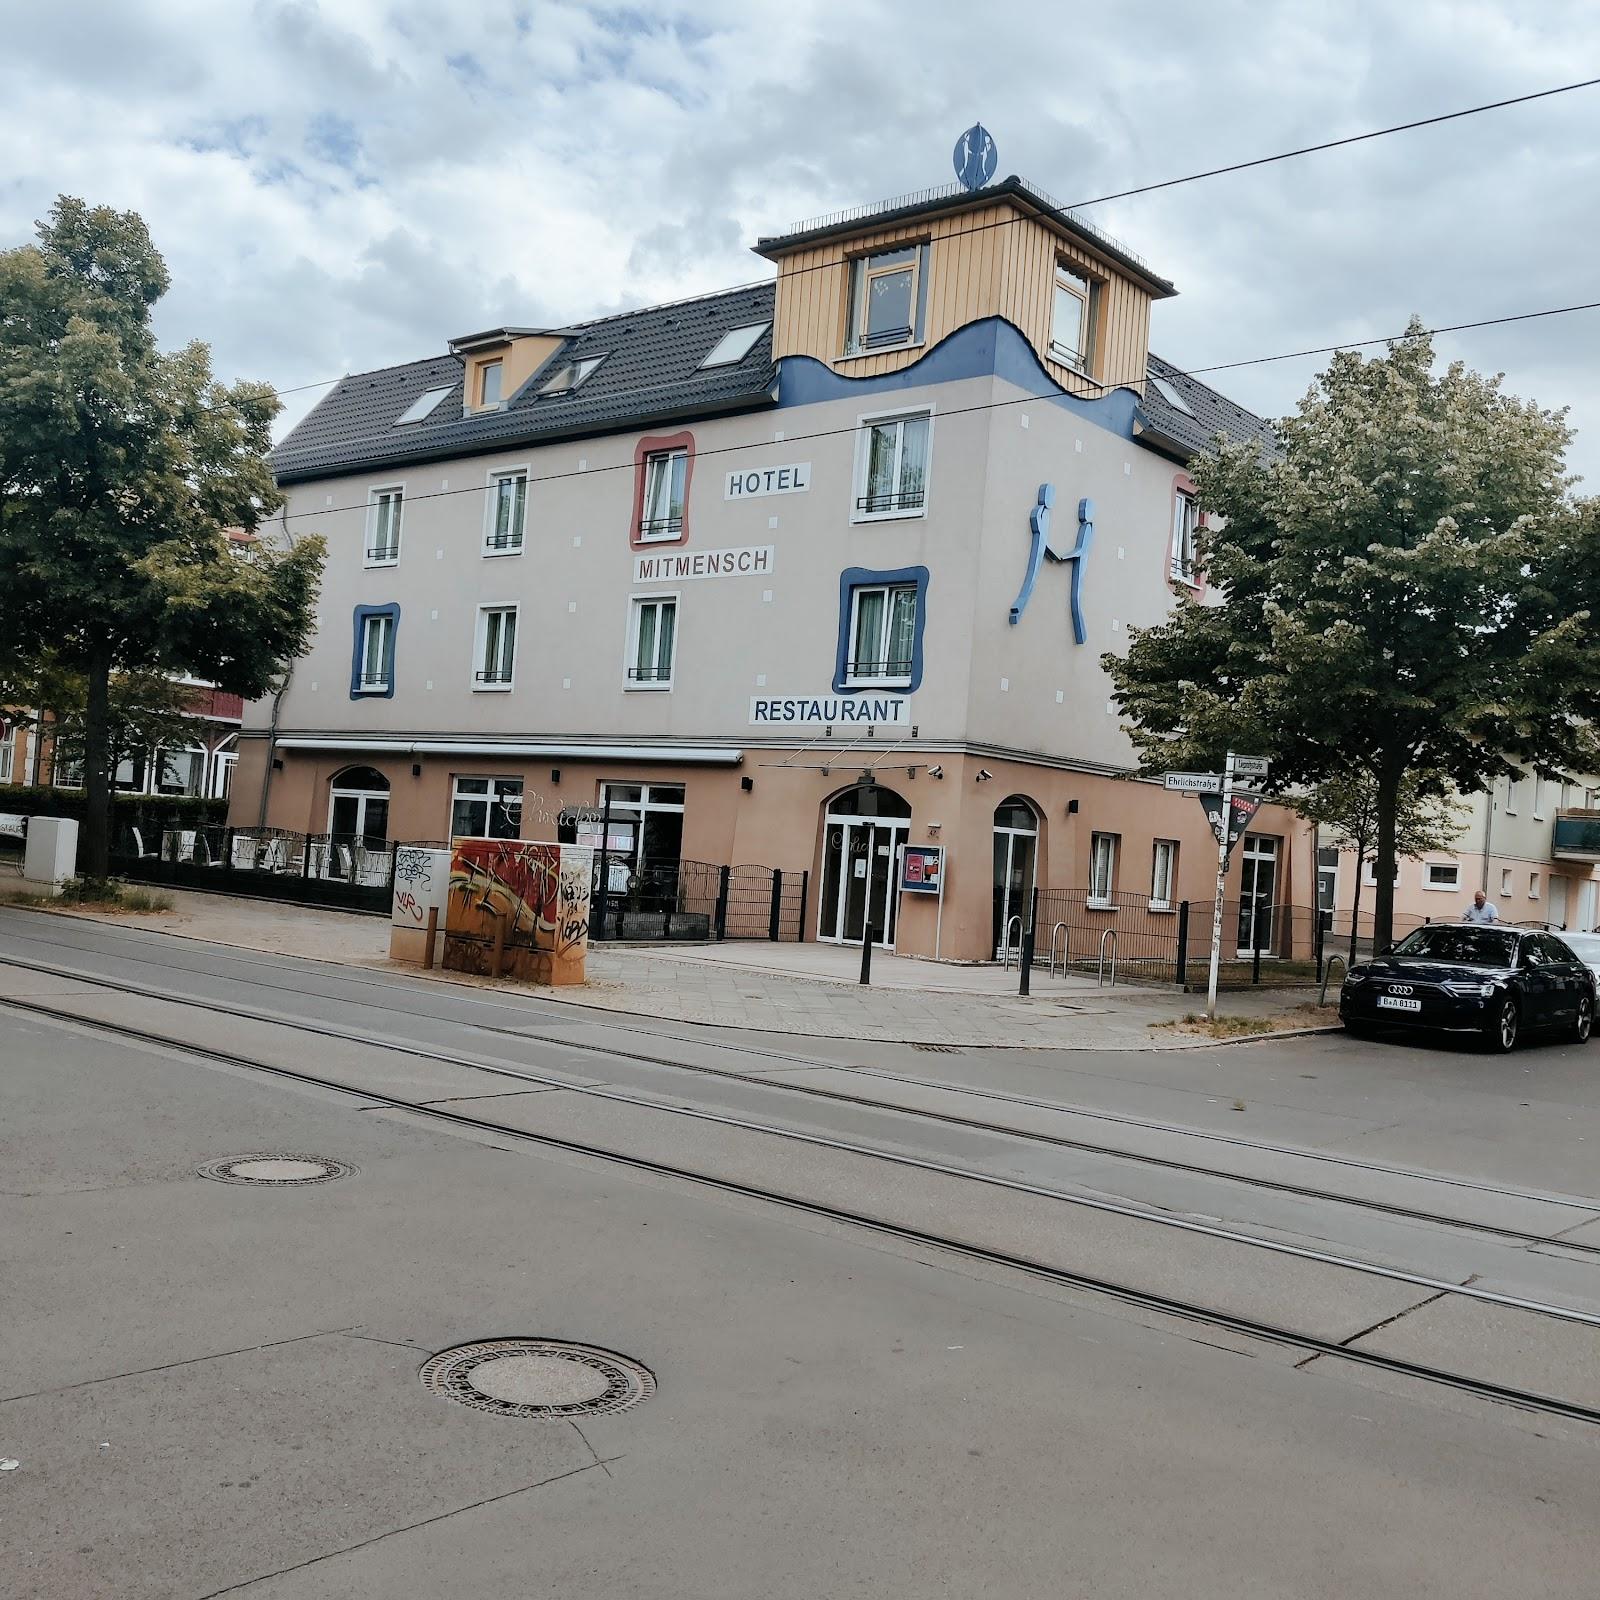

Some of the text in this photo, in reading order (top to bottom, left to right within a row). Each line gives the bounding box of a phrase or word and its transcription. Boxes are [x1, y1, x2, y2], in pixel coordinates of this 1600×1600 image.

[729, 467, 805, 495] HOTEL
[639, 550, 768, 579] MITMENSCH
[754, 700, 904, 722] RESTAURANT
[1168, 776, 1217, 789] Ehrlichstraße
